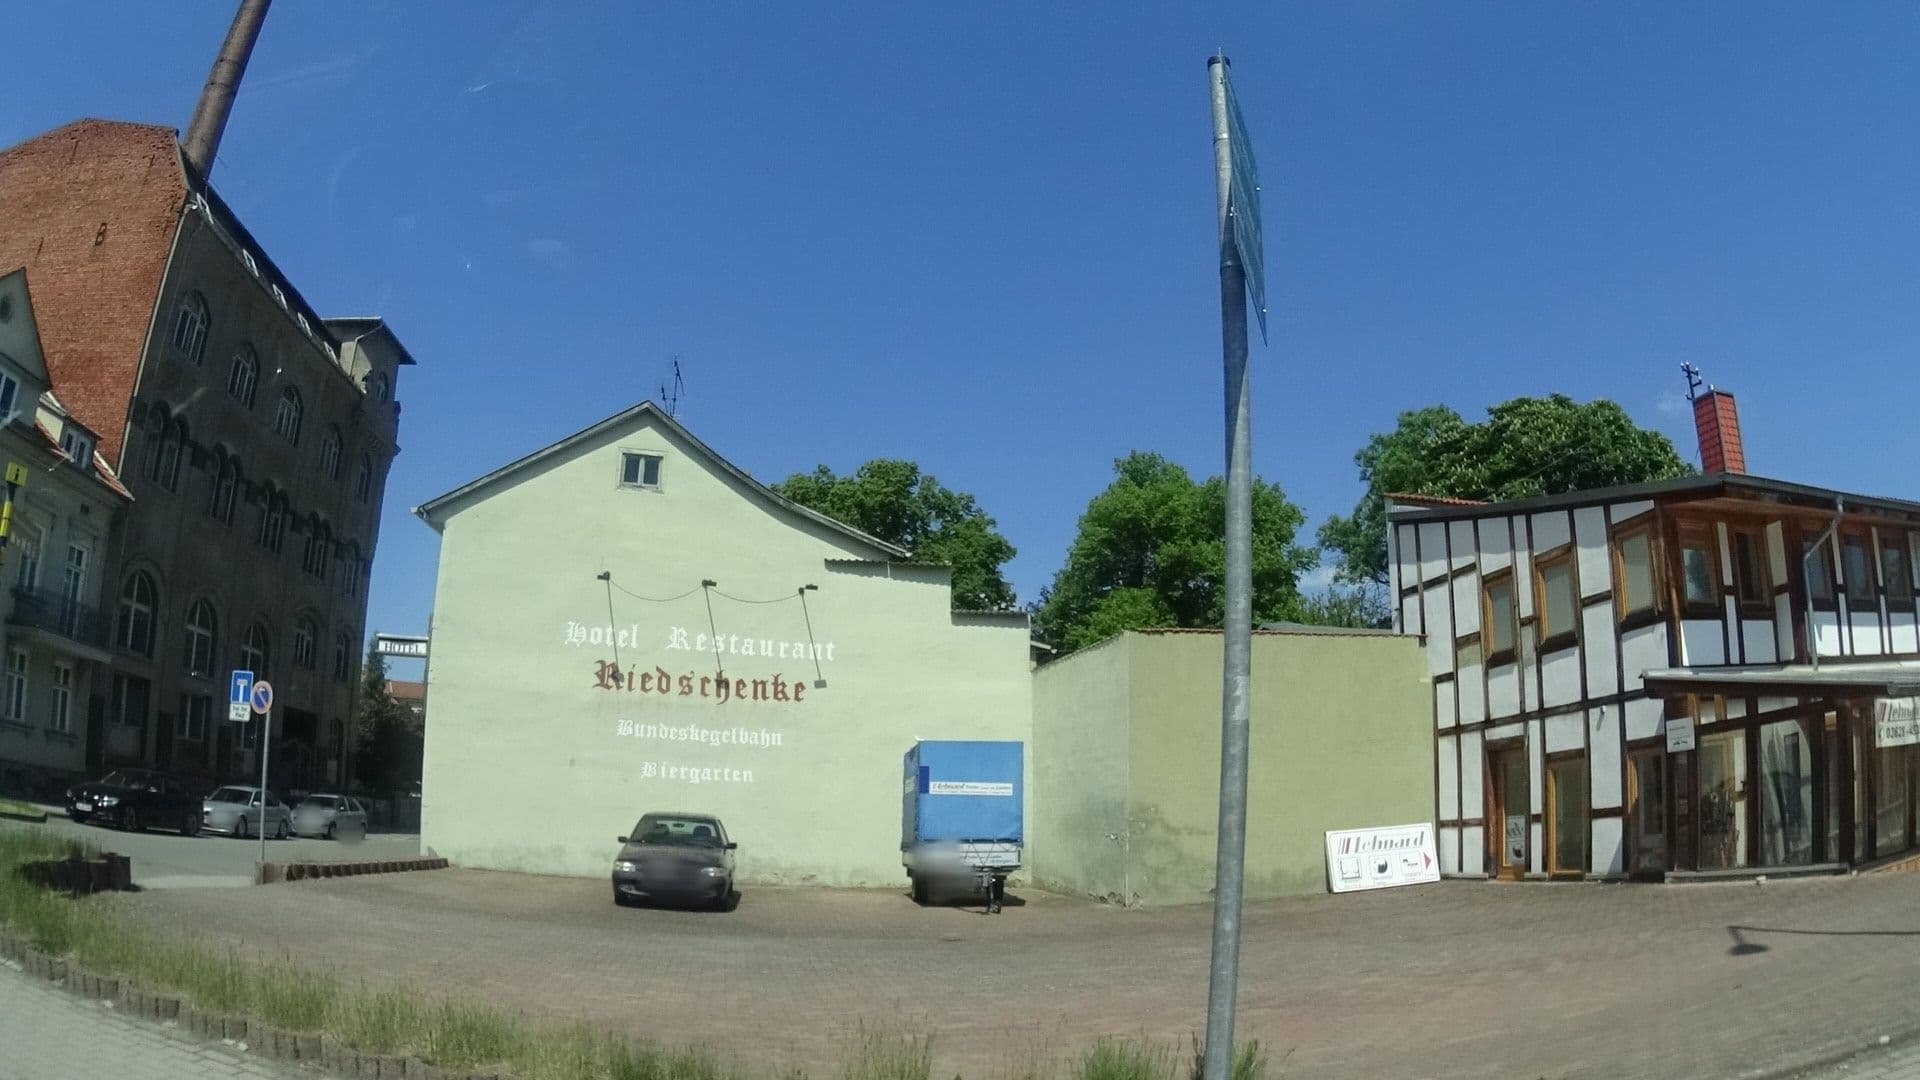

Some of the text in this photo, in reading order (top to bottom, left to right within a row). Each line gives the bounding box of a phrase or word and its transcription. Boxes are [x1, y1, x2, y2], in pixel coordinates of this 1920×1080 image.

[384, 641, 420, 654] HOTEL
[564, 621, 836, 661] Hotel Restaurant
[592, 660, 807, 705] Riedschenke
[616, 719, 783, 748] Bundeskegelbahn
[640, 761, 753, 784] Biergarten
